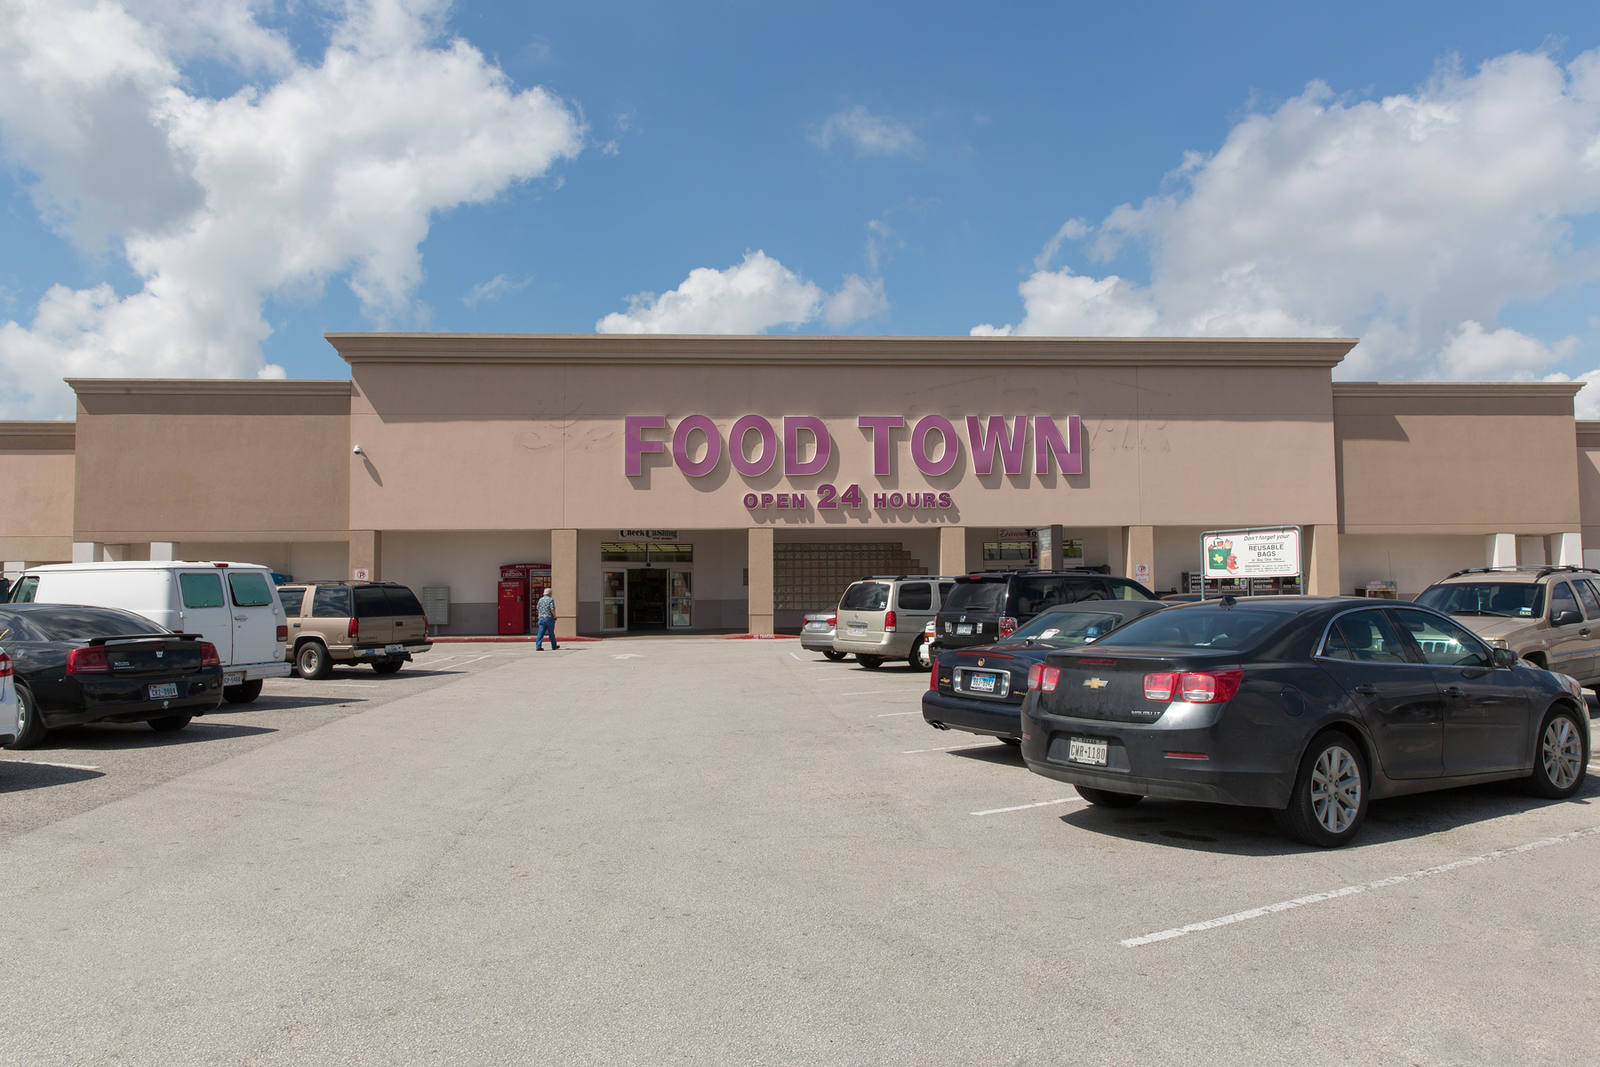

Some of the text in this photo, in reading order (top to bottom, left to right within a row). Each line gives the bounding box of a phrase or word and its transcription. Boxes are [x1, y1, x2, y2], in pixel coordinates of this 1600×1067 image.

[624, 414, 1081, 477] FOOD TOWN
[743, 483, 952, 510] OPEN 24 HOURS
